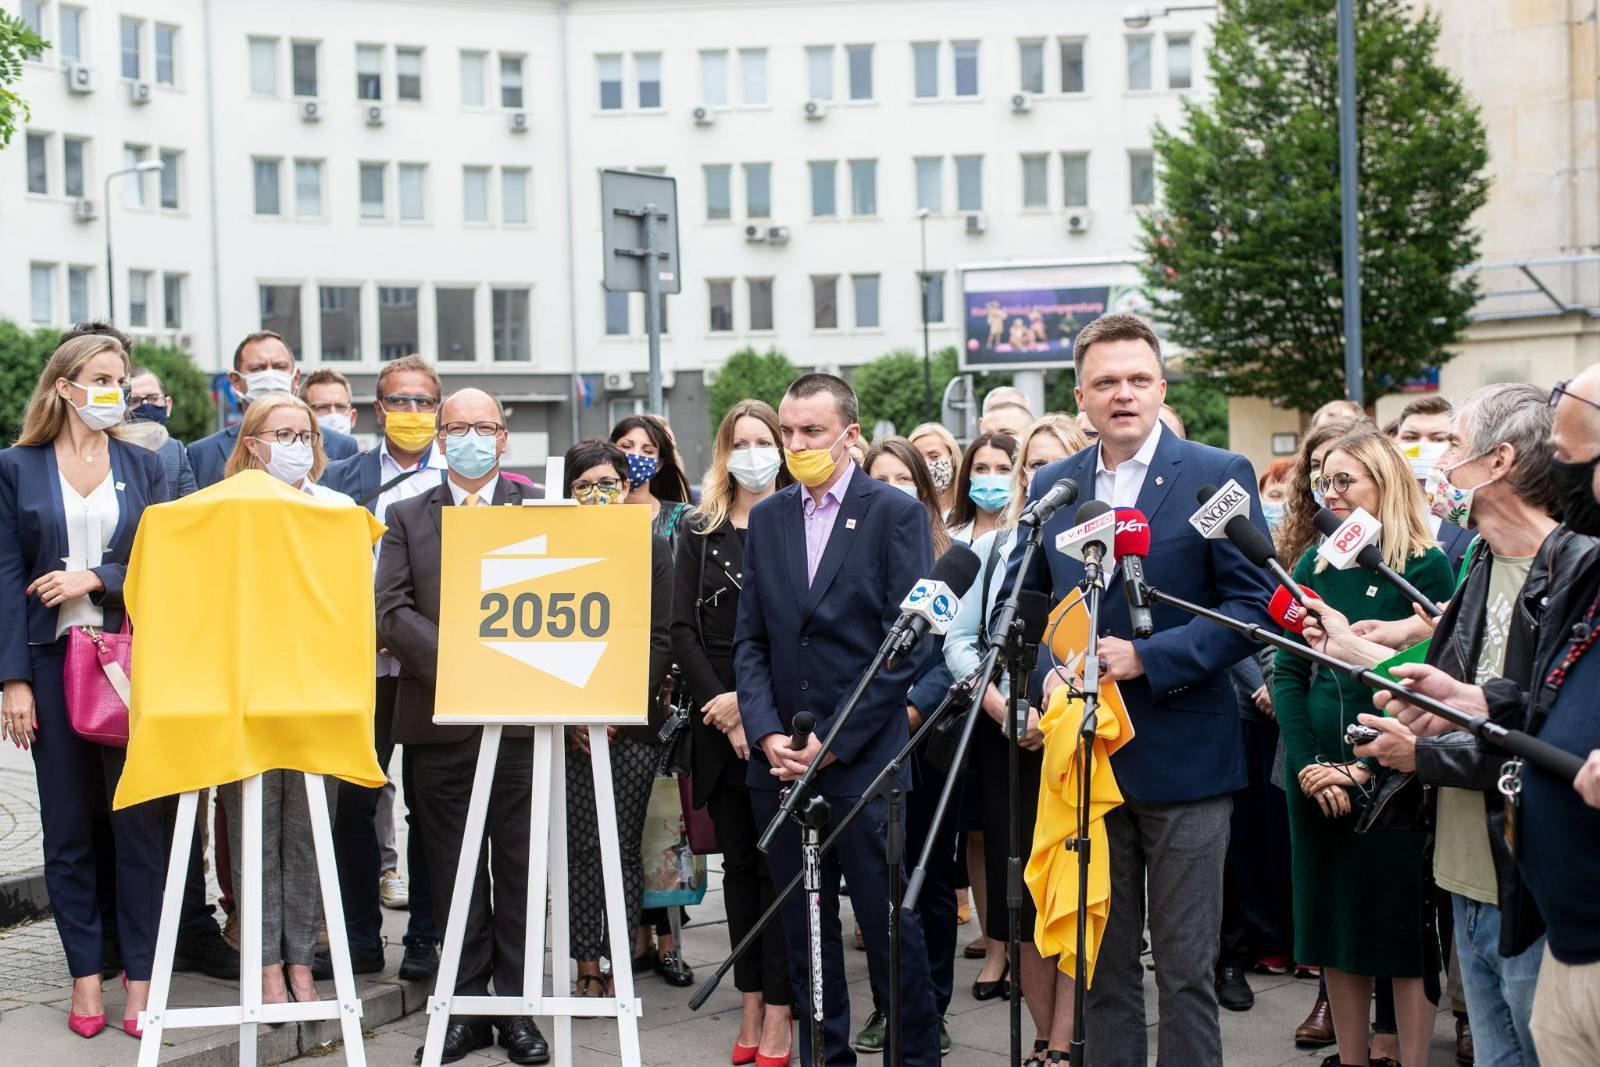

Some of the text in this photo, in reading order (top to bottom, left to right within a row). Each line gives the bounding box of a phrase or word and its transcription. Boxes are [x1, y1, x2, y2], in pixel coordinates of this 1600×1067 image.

[1085, 515, 1112, 533] INFO
[1200, 490, 1243, 532] ANGORA
[1116, 519, 1148, 536] ZET
[1336, 524, 1361, 552] pap
[479, 592, 610, 638] 2050
